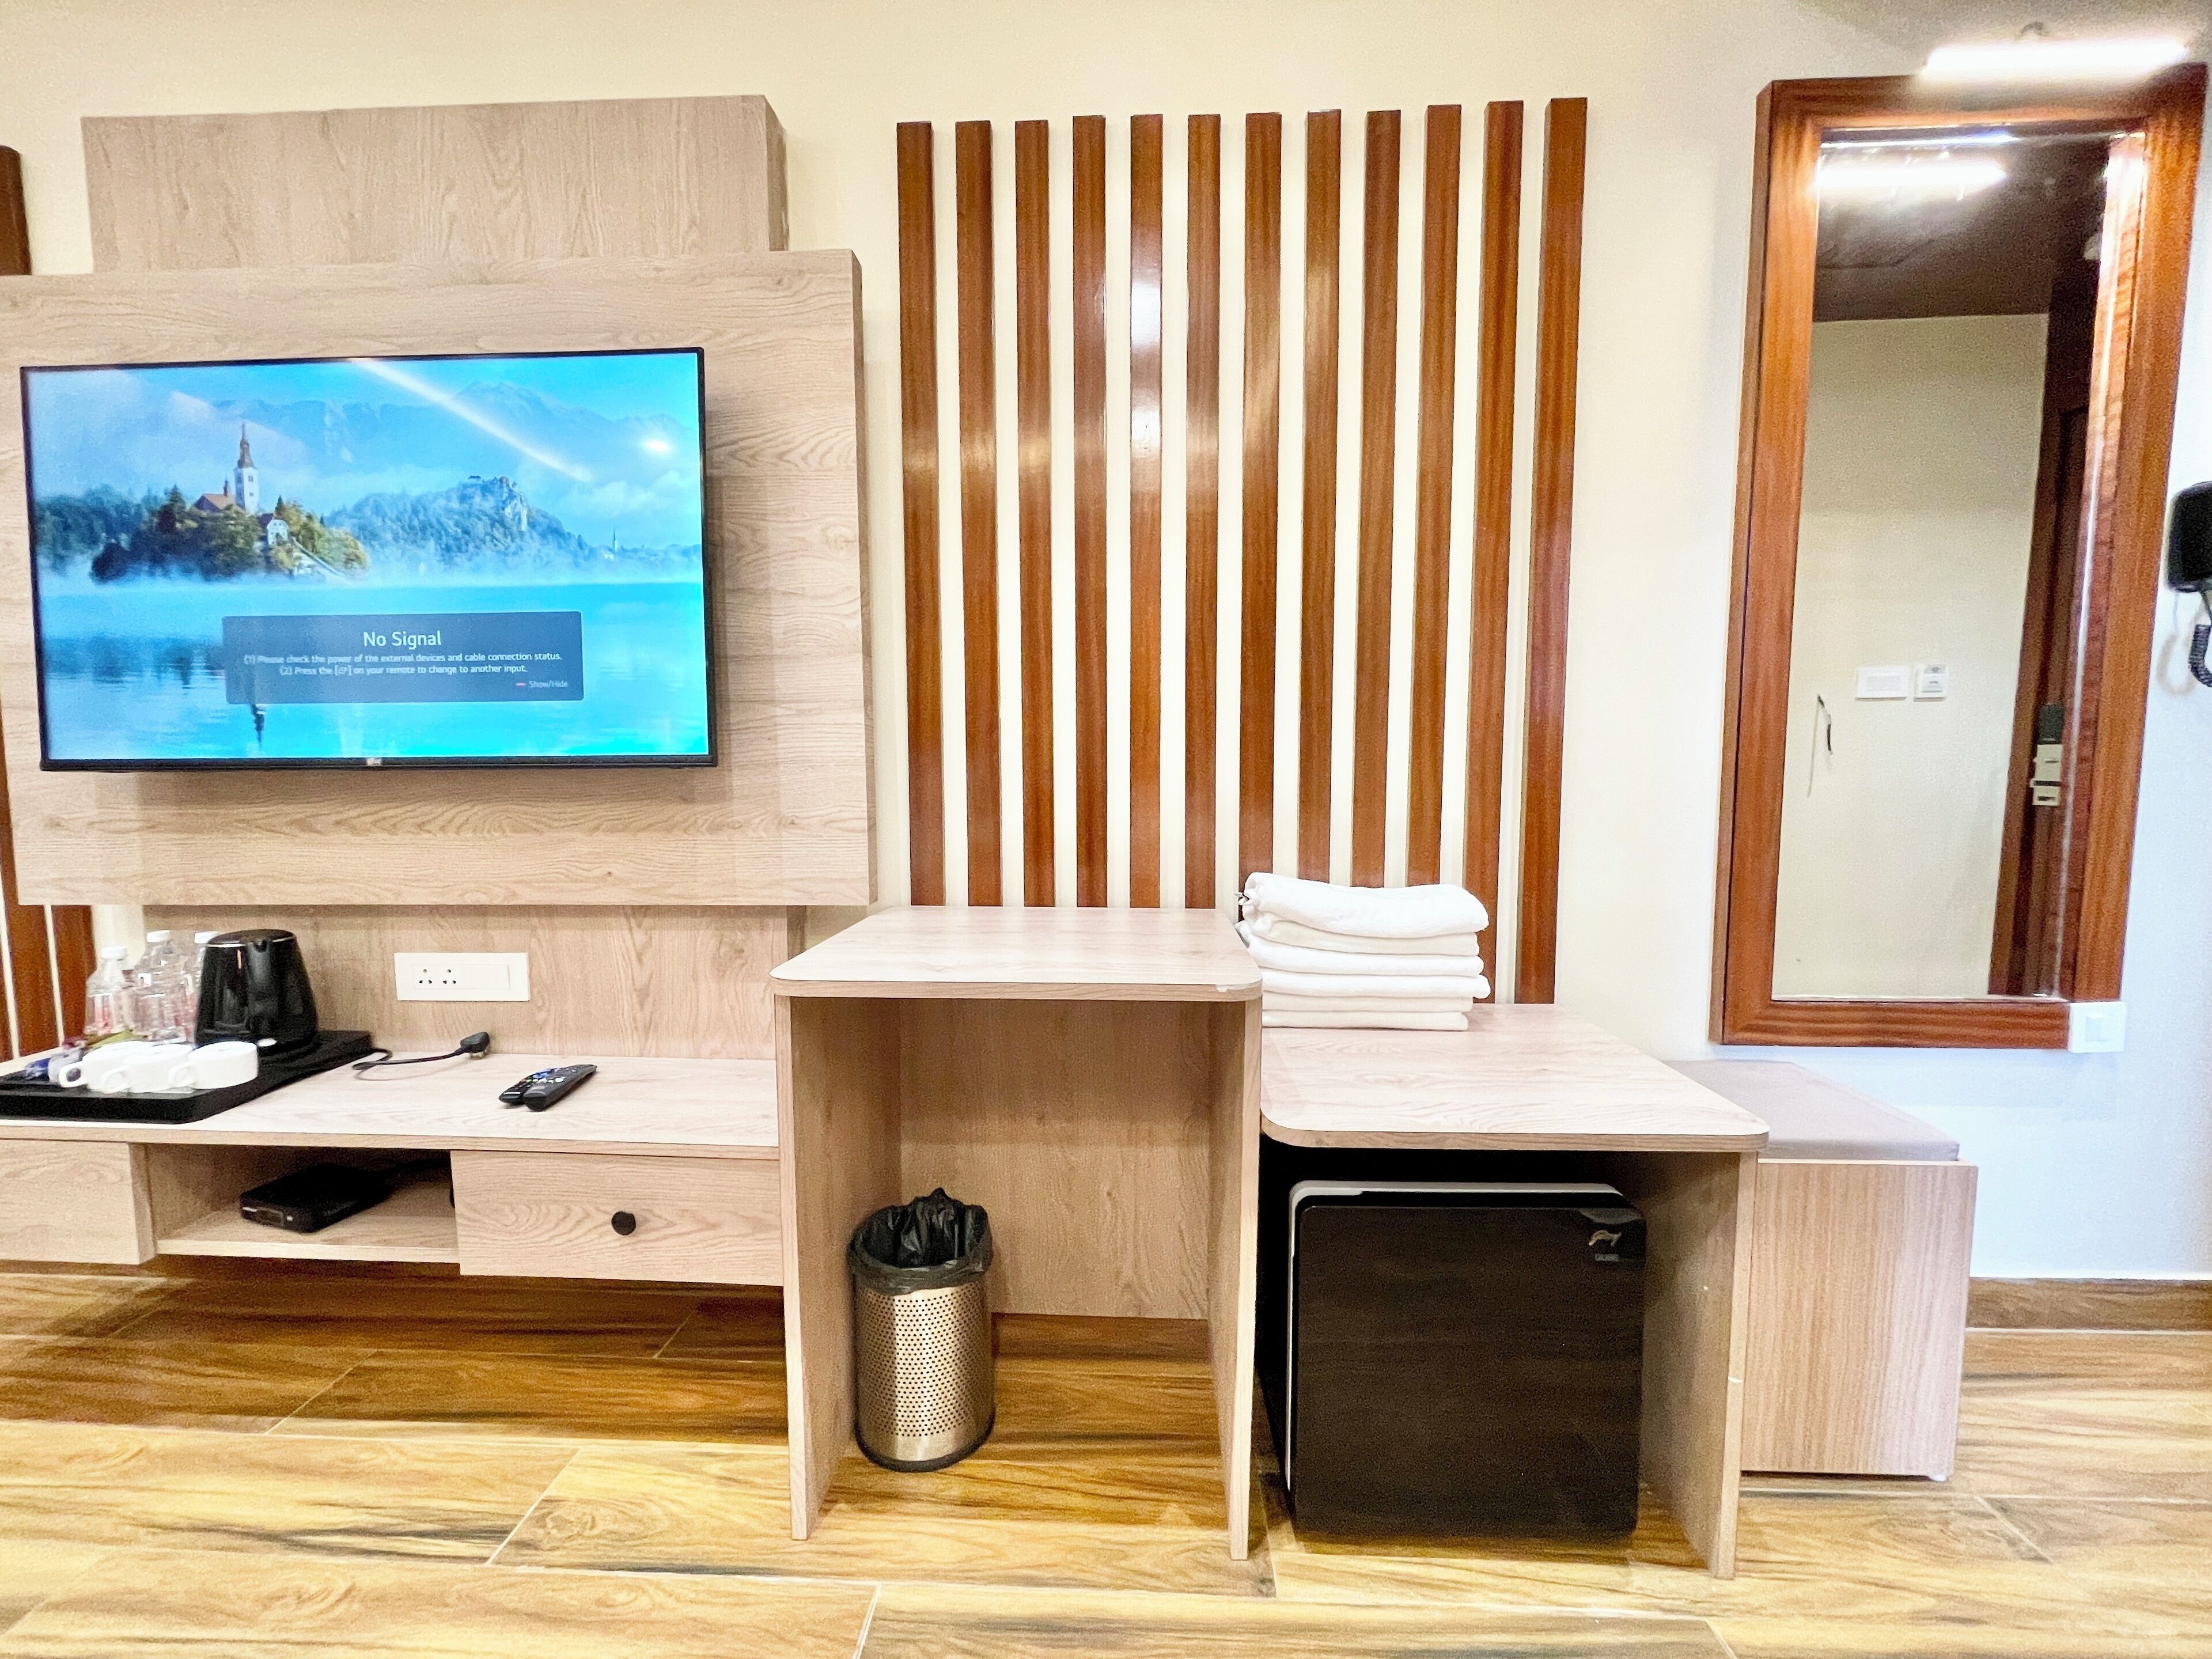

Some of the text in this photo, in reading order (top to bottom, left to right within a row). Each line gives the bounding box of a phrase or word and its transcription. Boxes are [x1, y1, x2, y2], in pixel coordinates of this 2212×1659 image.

[363, 630, 442, 650] No Signal
[327, 656, 352, 664] power
[354, 654, 363, 662] of
[380, 654, 414, 662] external
[415, 654, 445, 662] devices
[448, 653, 463, 661] and
[464, 653, 486, 661] cable
[488, 653, 532, 661] connection
[535, 652, 562, 661] status.
[279, 665, 292, 676] (2)
[366, 668, 384, 676] your
[429, 666, 457, 675] change
[470, 664, 502, 673] another
[504, 664, 528, 674] input.
[528, 680, 569, 688] Show/Hide
